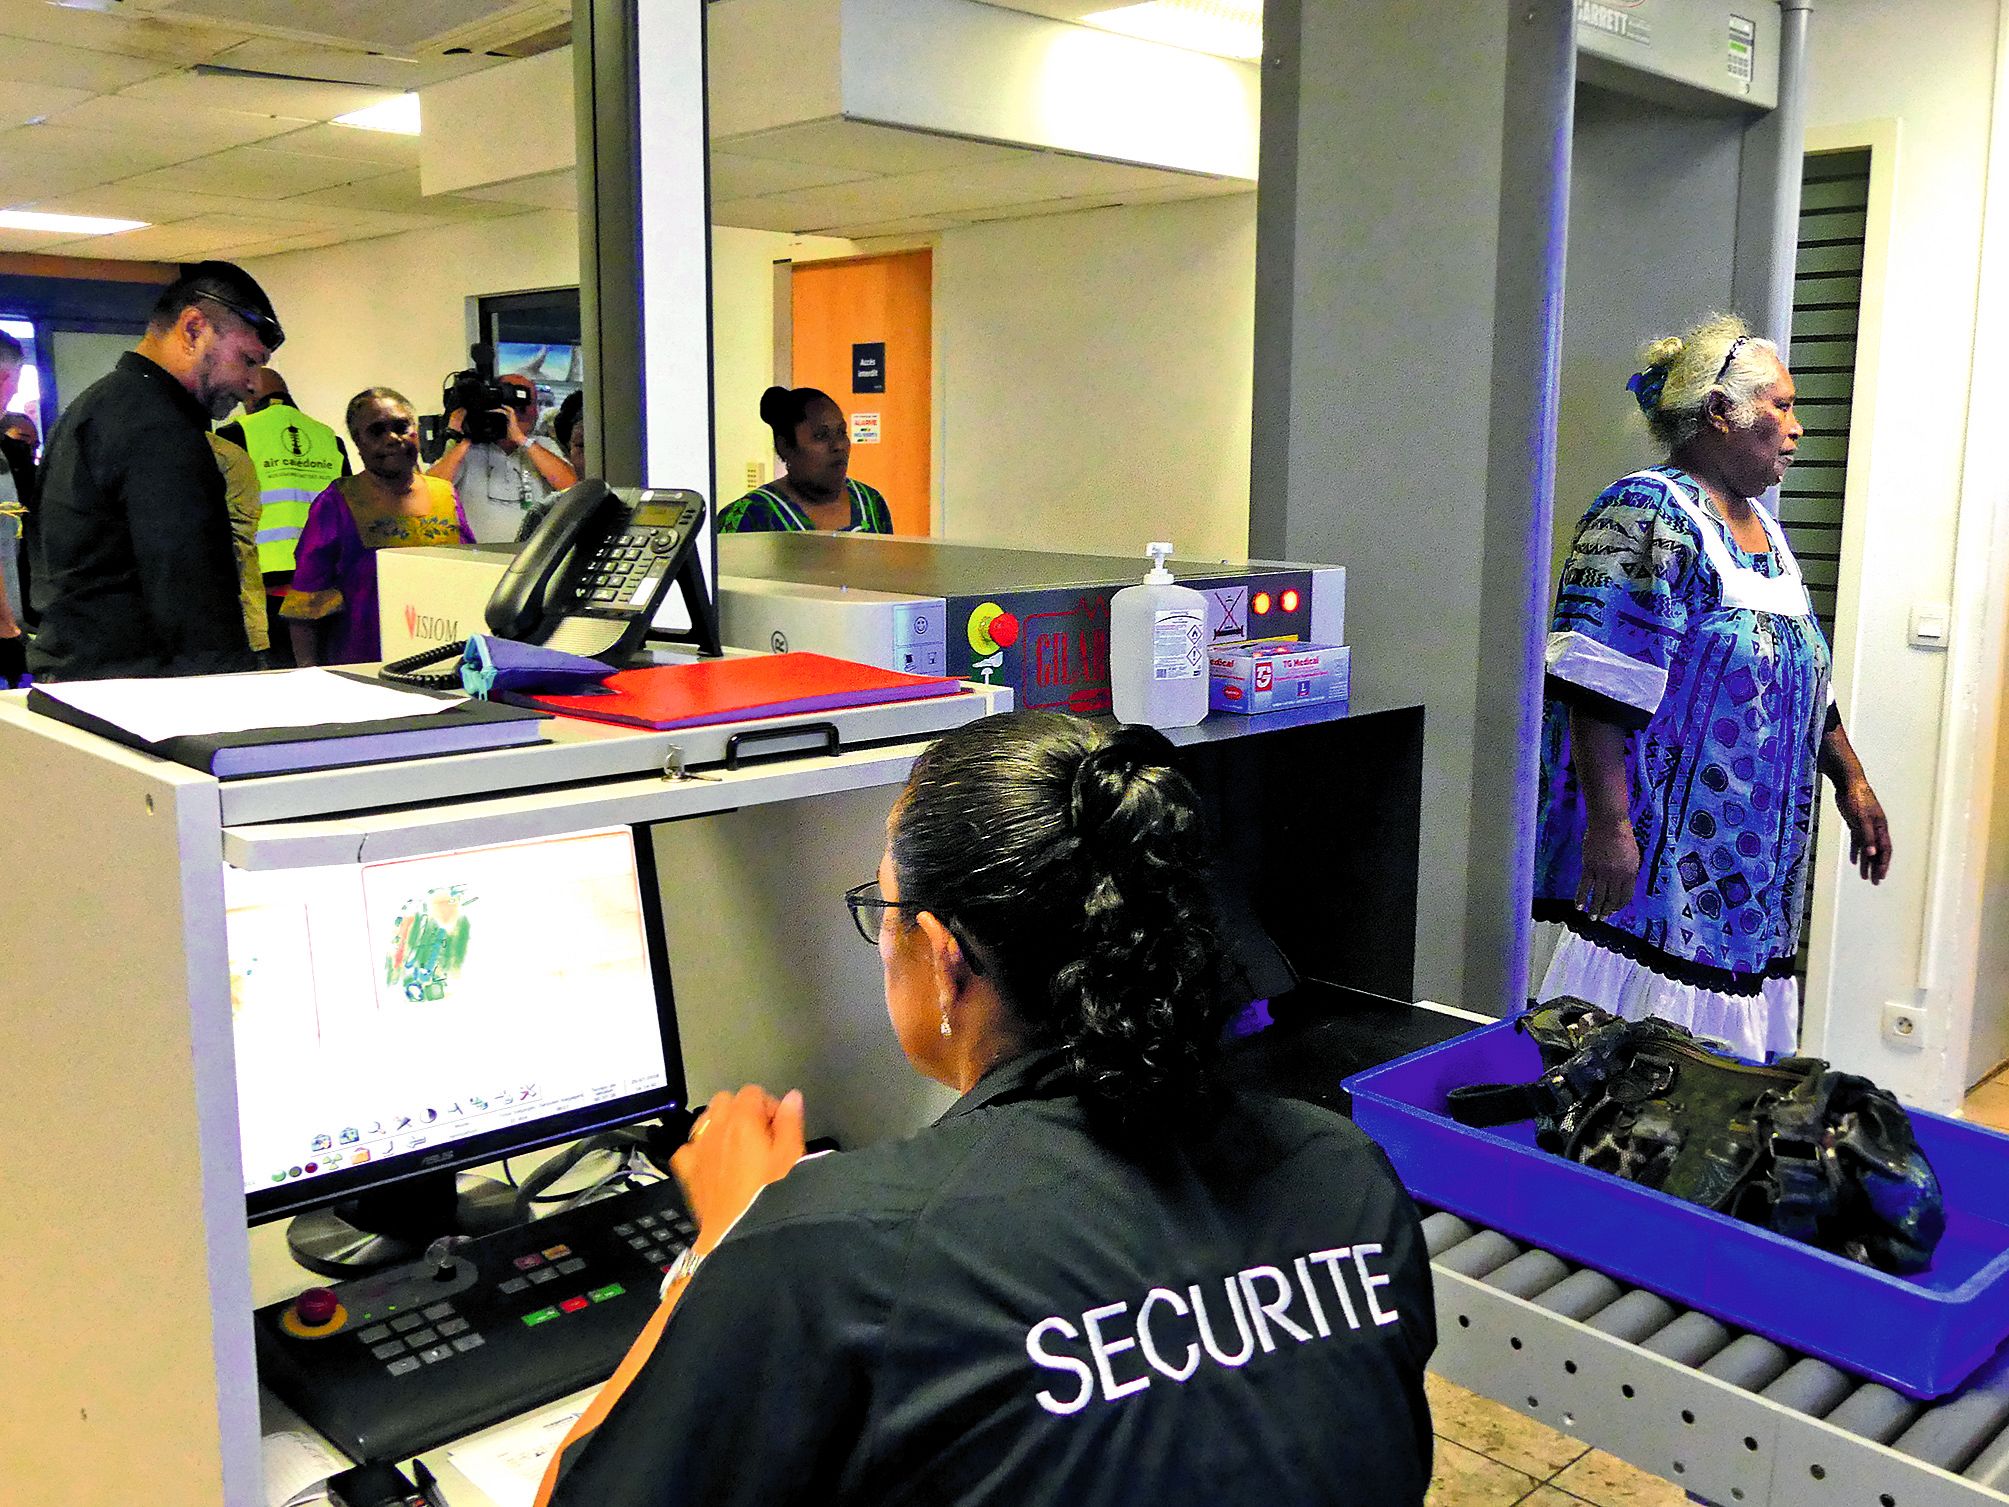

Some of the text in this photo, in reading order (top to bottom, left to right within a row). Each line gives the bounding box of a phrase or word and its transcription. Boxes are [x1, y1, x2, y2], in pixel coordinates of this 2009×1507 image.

[263, 458, 279, 468] air
[405, 604, 458, 642] VISIOM
[1026, 1243, 1398, 1415] SECURITE
